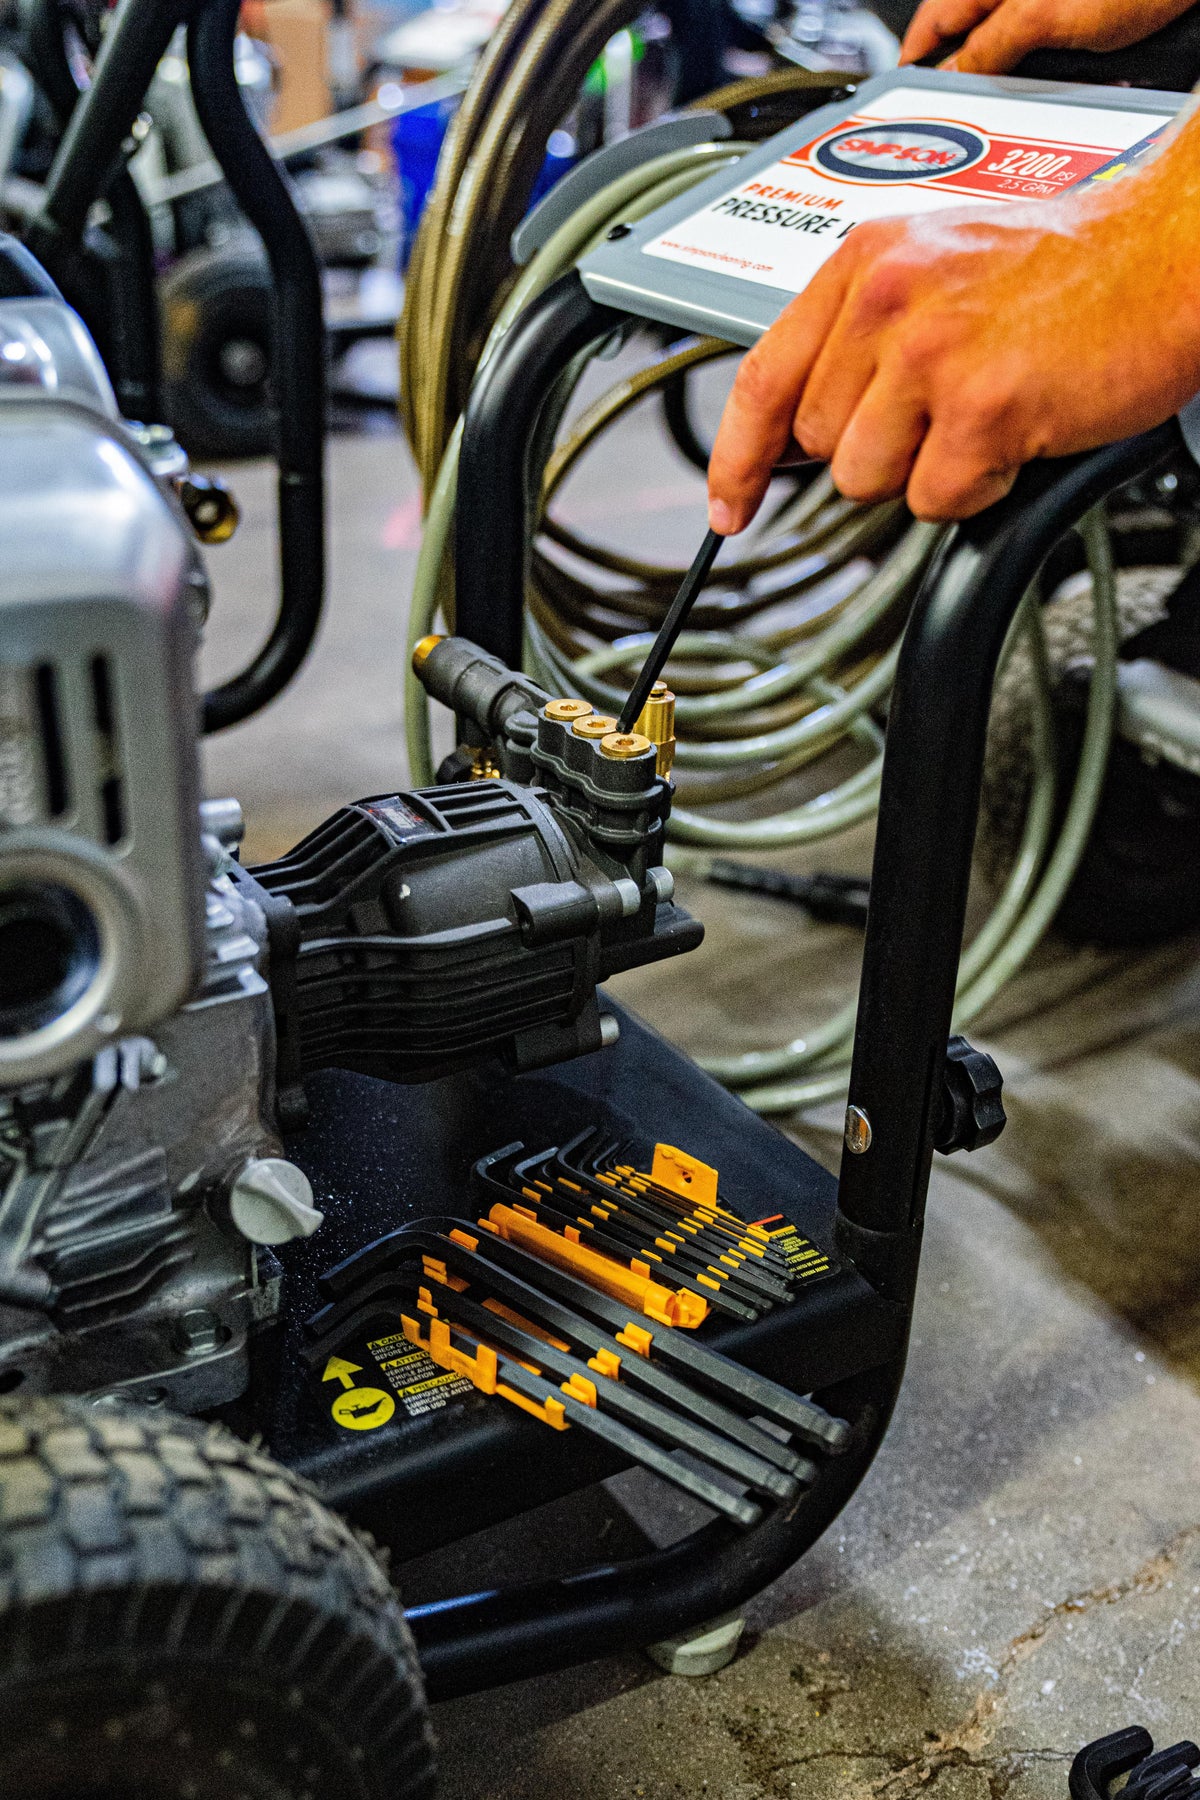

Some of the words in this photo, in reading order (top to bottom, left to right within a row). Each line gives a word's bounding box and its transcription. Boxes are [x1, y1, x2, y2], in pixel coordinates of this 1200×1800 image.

[987, 149, 1072, 178] 3200
[1052, 172, 1078, 182] PSI
[997, 179, 1020, 190] 2.5
[1021, 183, 1057, 195] GPM
[742, 183, 844, 211] PREMIUM
[711, 197, 841, 235] PRESSURE
[371, 1344, 395, 1355] CHECK
[374, 1349, 402, 1361] BEFORE
[402, 1344, 417, 1352] EAC
[406, 1391, 450, 1410] LUBRICANTE
[409, 1405, 431, 1416] CADA
[430, 1399, 447, 1410] USO
